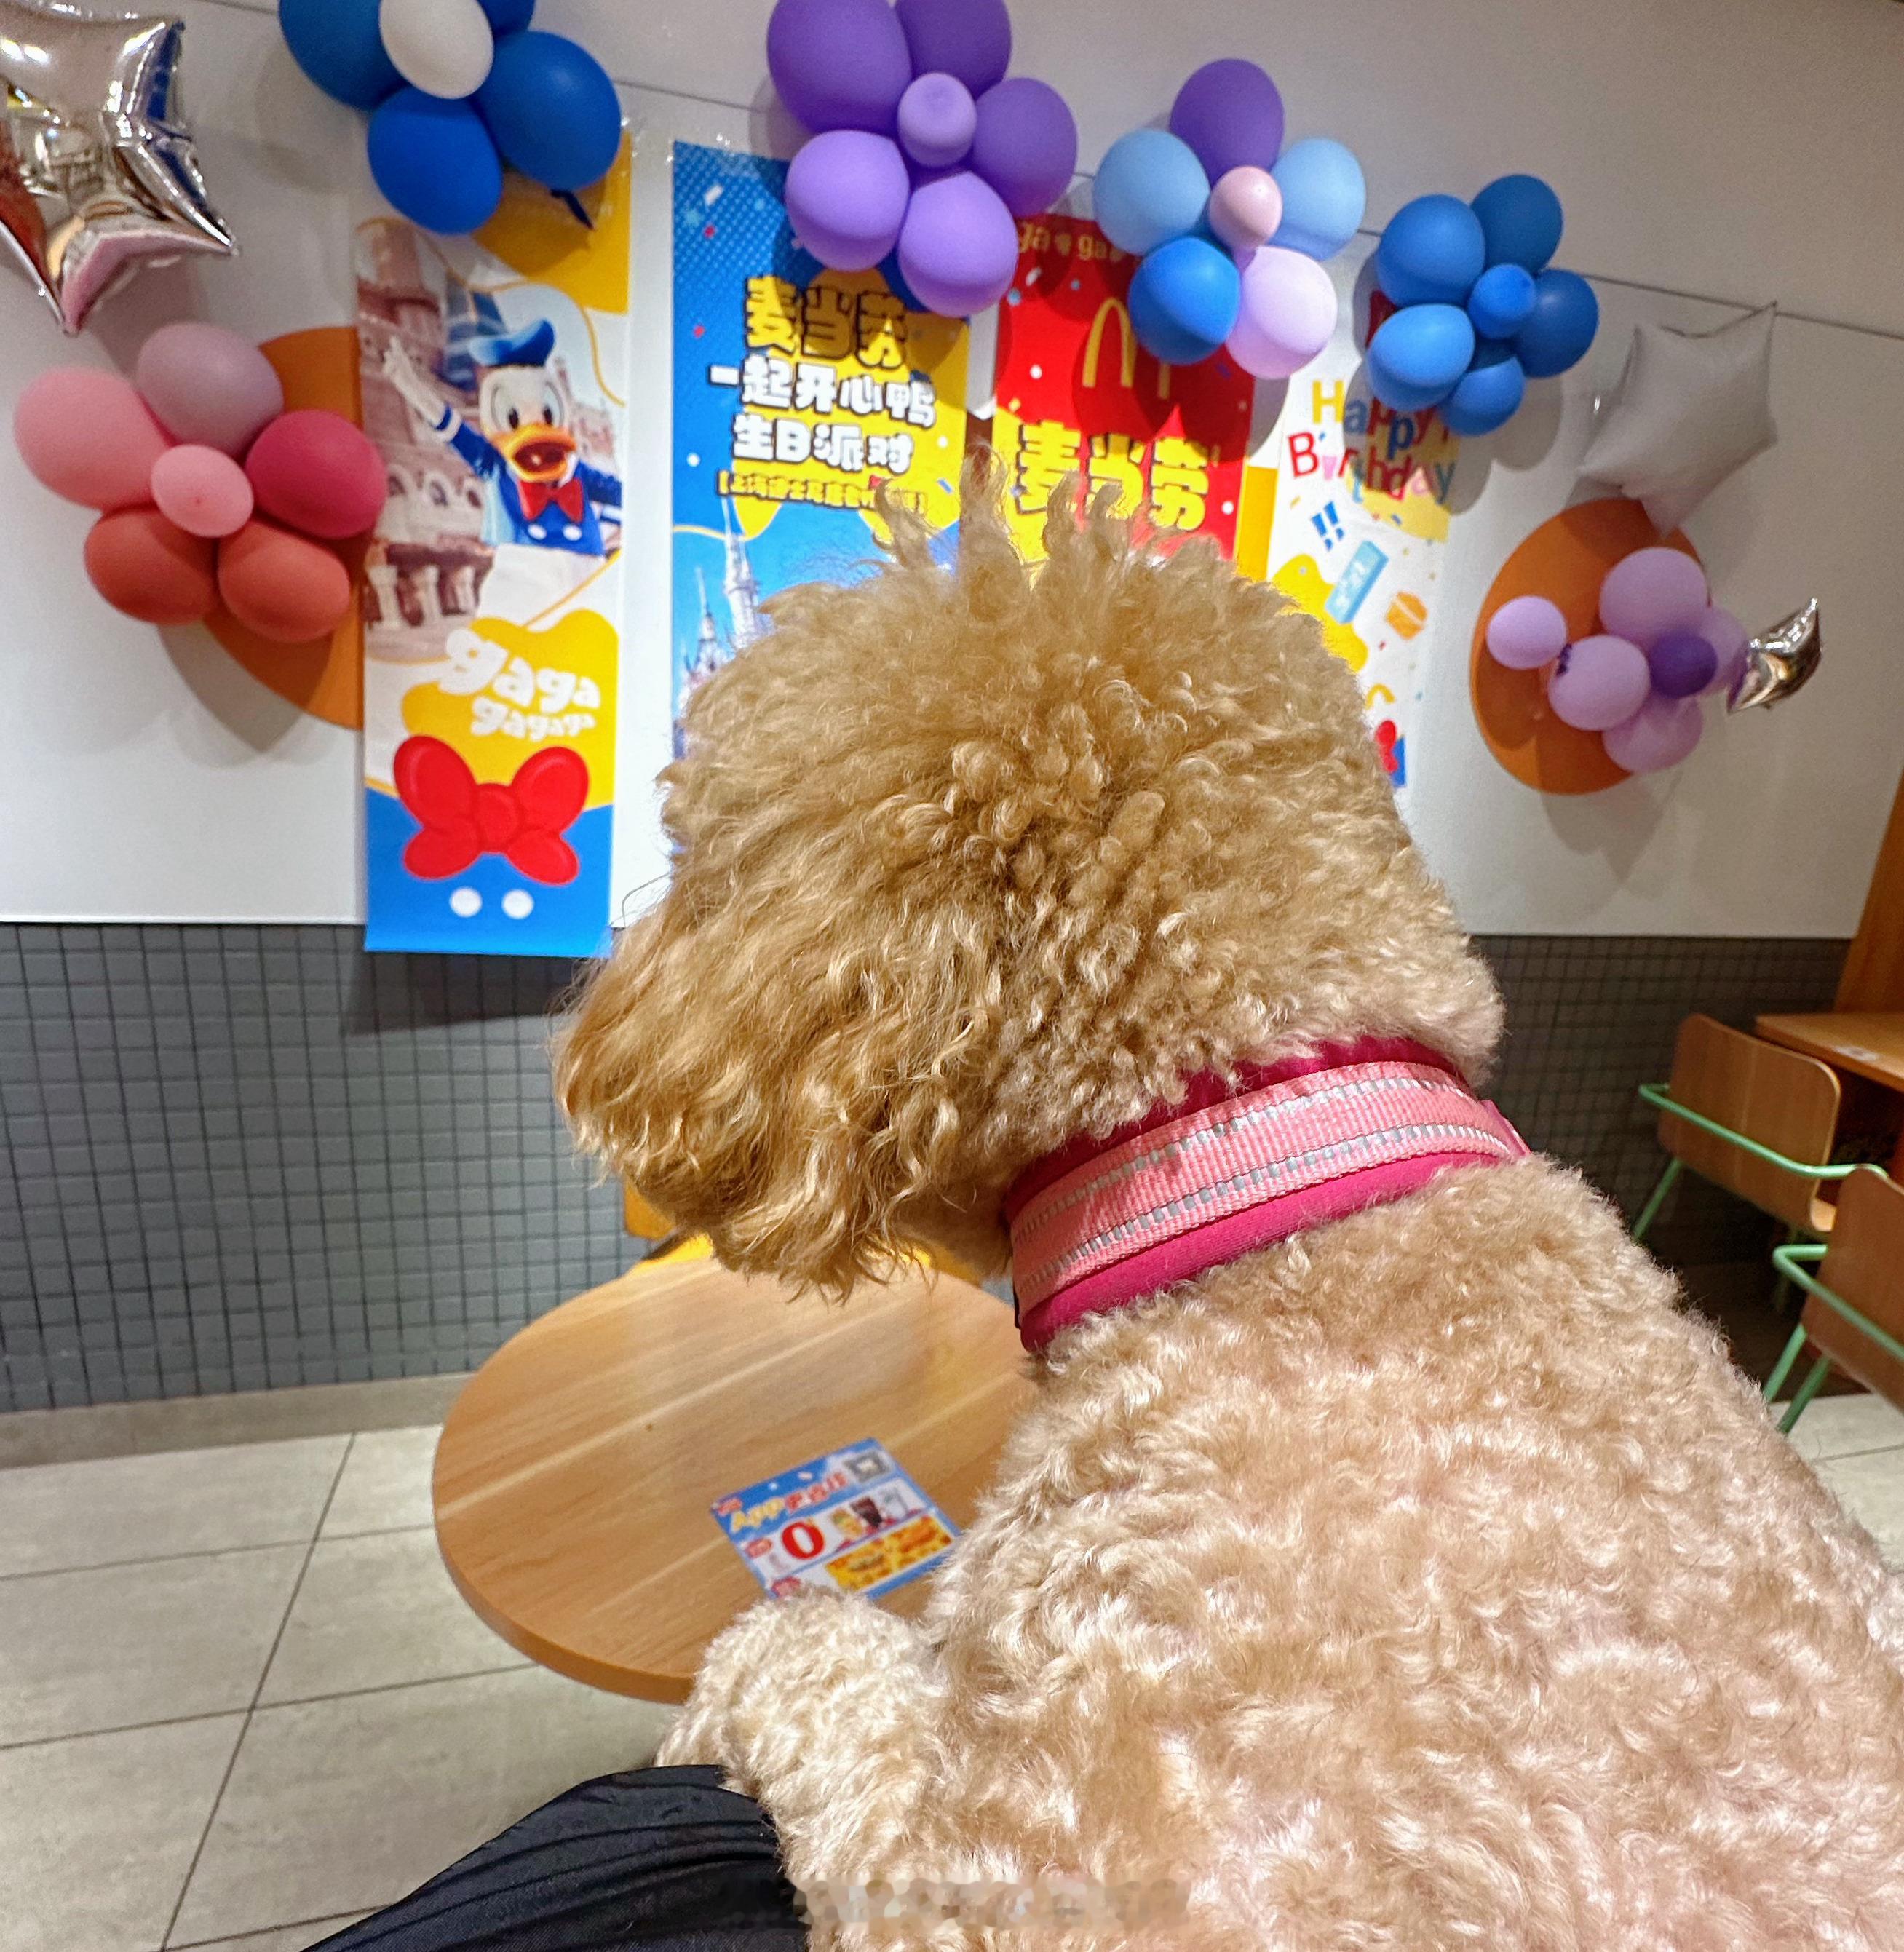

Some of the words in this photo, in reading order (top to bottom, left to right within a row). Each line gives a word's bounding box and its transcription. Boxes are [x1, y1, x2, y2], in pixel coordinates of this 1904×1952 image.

[745, 275, 909, 370] 麦当劳
[707, 353, 937, 428] 一起开心鸭
[731, 412, 915, 475] 生日派对
[1018, 419, 1210, 531] 麦当劳
[440, 629, 600, 713] gaga
